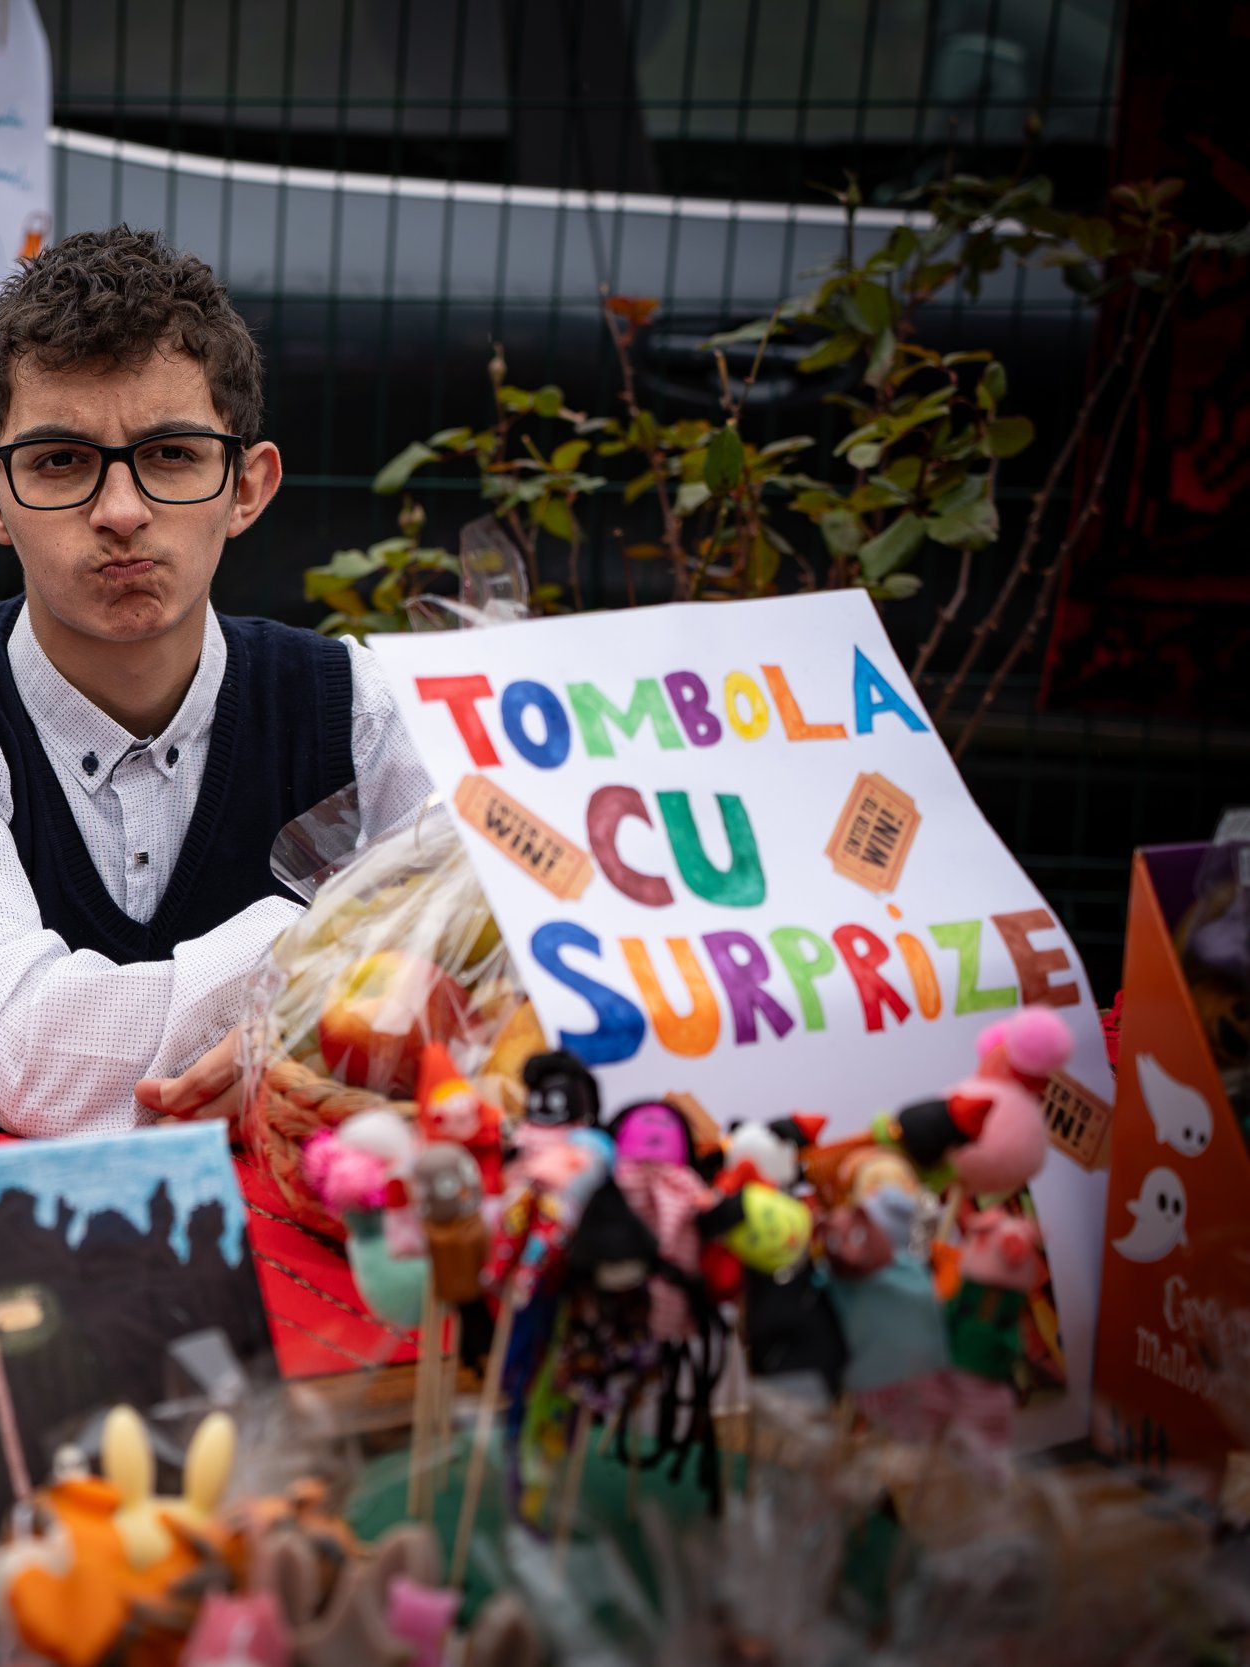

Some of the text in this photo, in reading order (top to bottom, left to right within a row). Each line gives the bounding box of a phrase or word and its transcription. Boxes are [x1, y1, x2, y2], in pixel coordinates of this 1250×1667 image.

[414, 644, 929, 769] TOMBOLA
[486, 808, 555, 878] WIN!
[586, 785, 767, 907] CU
[844, 815, 870, 856] ENTER
[860, 808, 904, 868] WIN!
[1043, 1100, 1085, 1148] IN!
